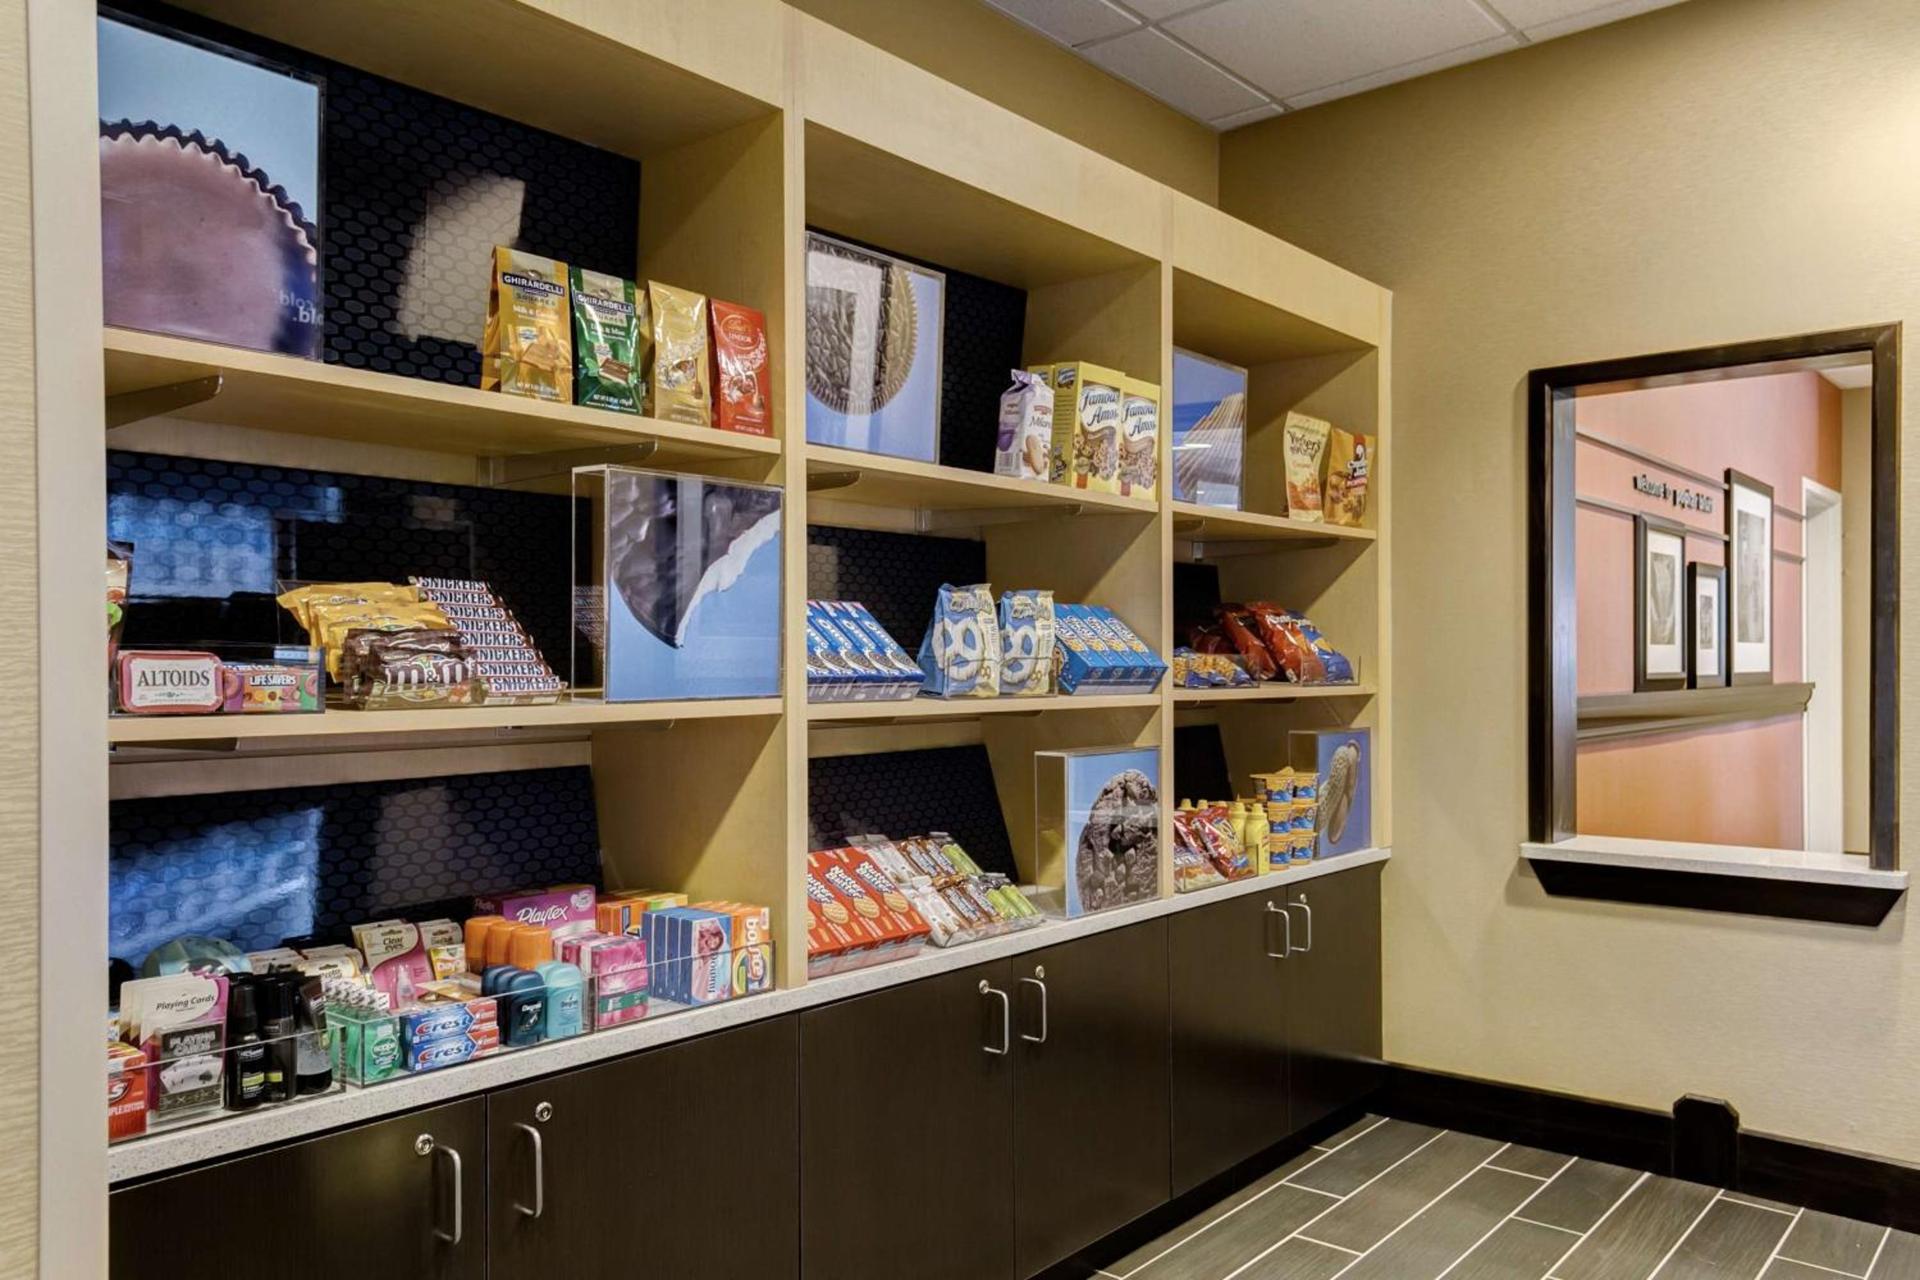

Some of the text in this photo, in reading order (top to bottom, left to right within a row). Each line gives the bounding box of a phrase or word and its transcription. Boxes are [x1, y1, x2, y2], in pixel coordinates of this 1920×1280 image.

[504, 275, 564, 295] GHIRARDELLI
[577, 294, 632, 312] GHIRARDELLI
[422, 577, 484, 591] SNICKERS
[431, 591, 493, 604] SNICKERS
[461, 632, 524, 646] SNICKERS
[479, 648, 534, 661] NICKERS
[480, 663, 543, 675] SNICKERS
[137, 670, 211, 687] ALTOIDS
[494, 677, 559, 691] SNICKERS
[516, 905, 569, 927] Playtex
[383, 937, 404, 946] Clear
[384, 943, 404, 952] eyes
[156, 994, 215, 1011] Playing Cards
[416, 1014, 471, 1036] Crest
[418, 1042, 473, 1063] Crest
